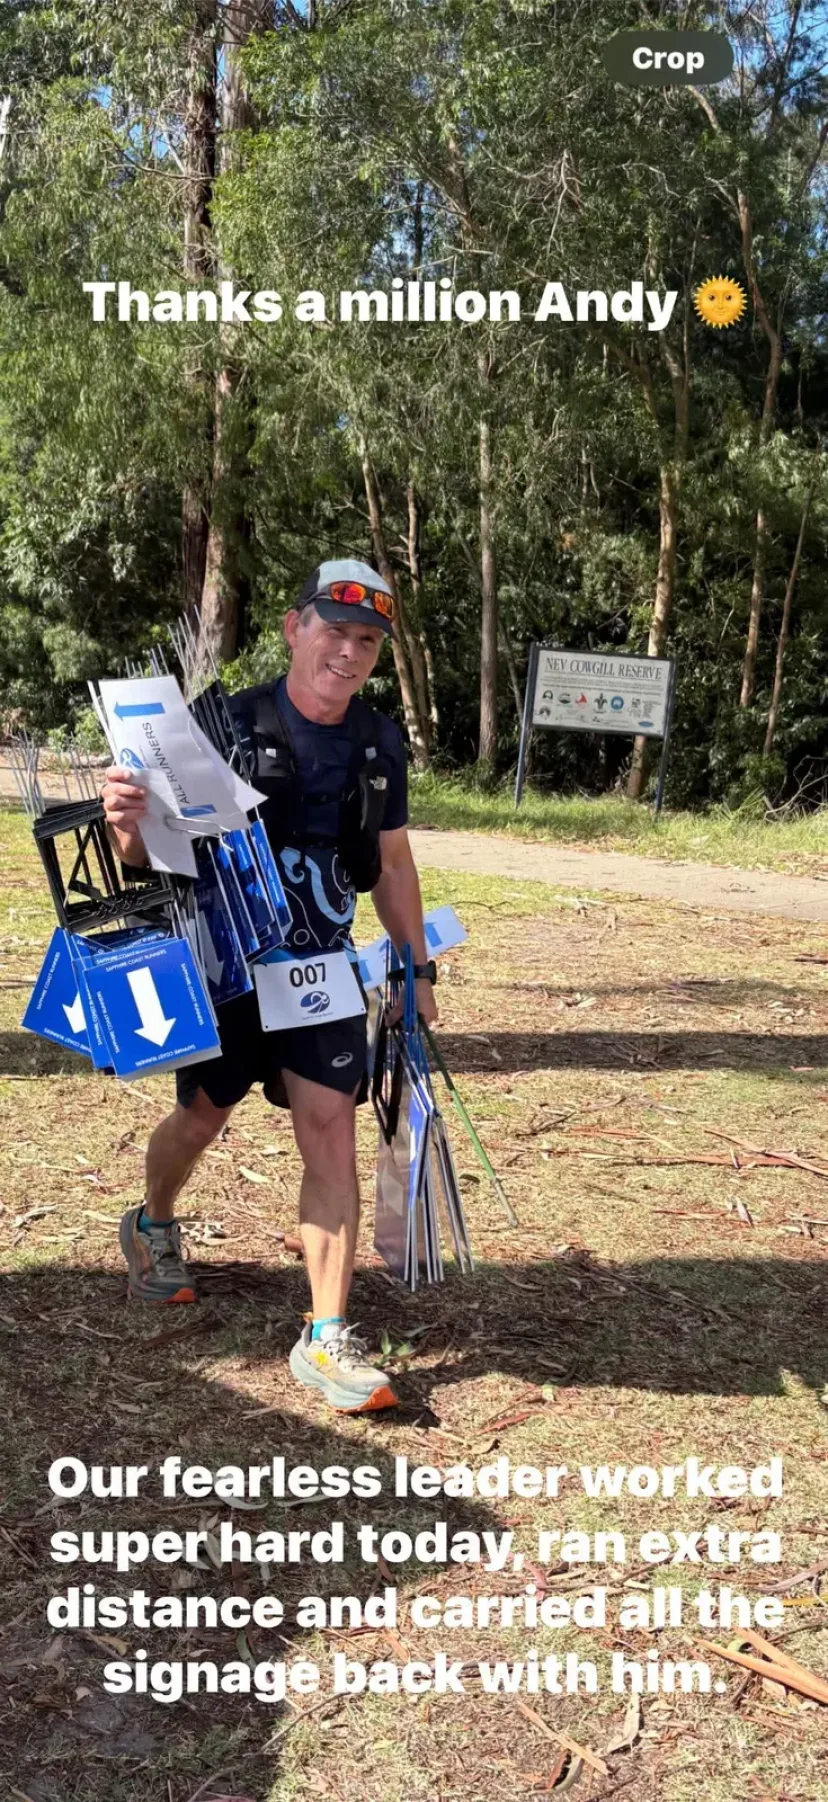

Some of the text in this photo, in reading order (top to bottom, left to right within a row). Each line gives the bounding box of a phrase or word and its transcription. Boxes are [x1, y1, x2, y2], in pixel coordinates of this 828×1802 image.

[545, 657, 663, 679] NEV COWGILL RESERVE
[142, 722, 178, 783] RUNNERS
[173, 784, 190, 804] ALL
[289, 962, 326, 987] 007
